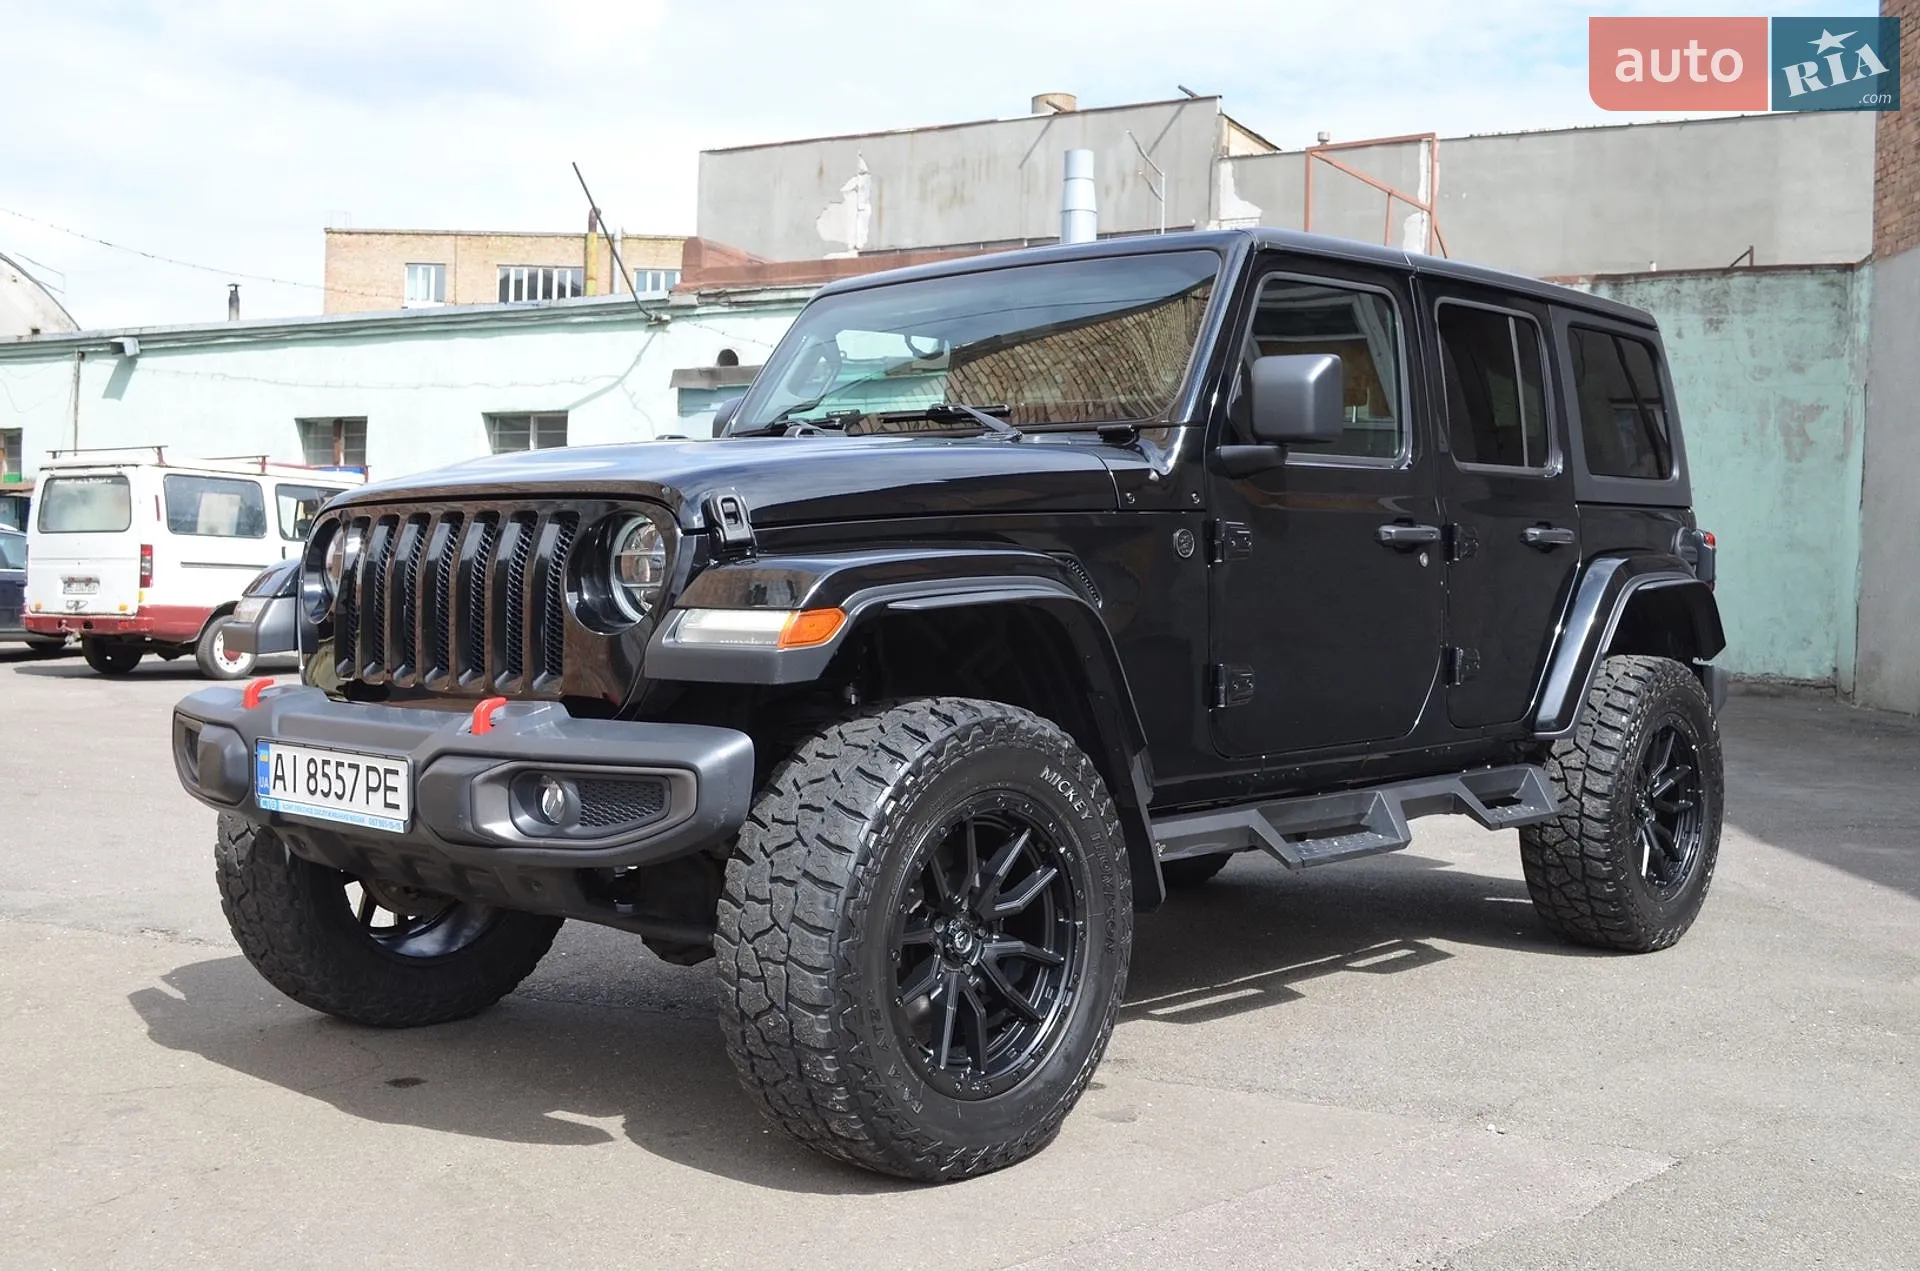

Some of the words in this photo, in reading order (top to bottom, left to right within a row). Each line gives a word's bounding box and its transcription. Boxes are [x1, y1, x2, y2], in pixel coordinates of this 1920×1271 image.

[258, 775, 269, 789] UA
[272, 753, 297, 793] AI
[306, 757, 360, 803] 8557
[366, 765, 400, 810] PE
[1039, 765, 1093, 820] MICKEY
